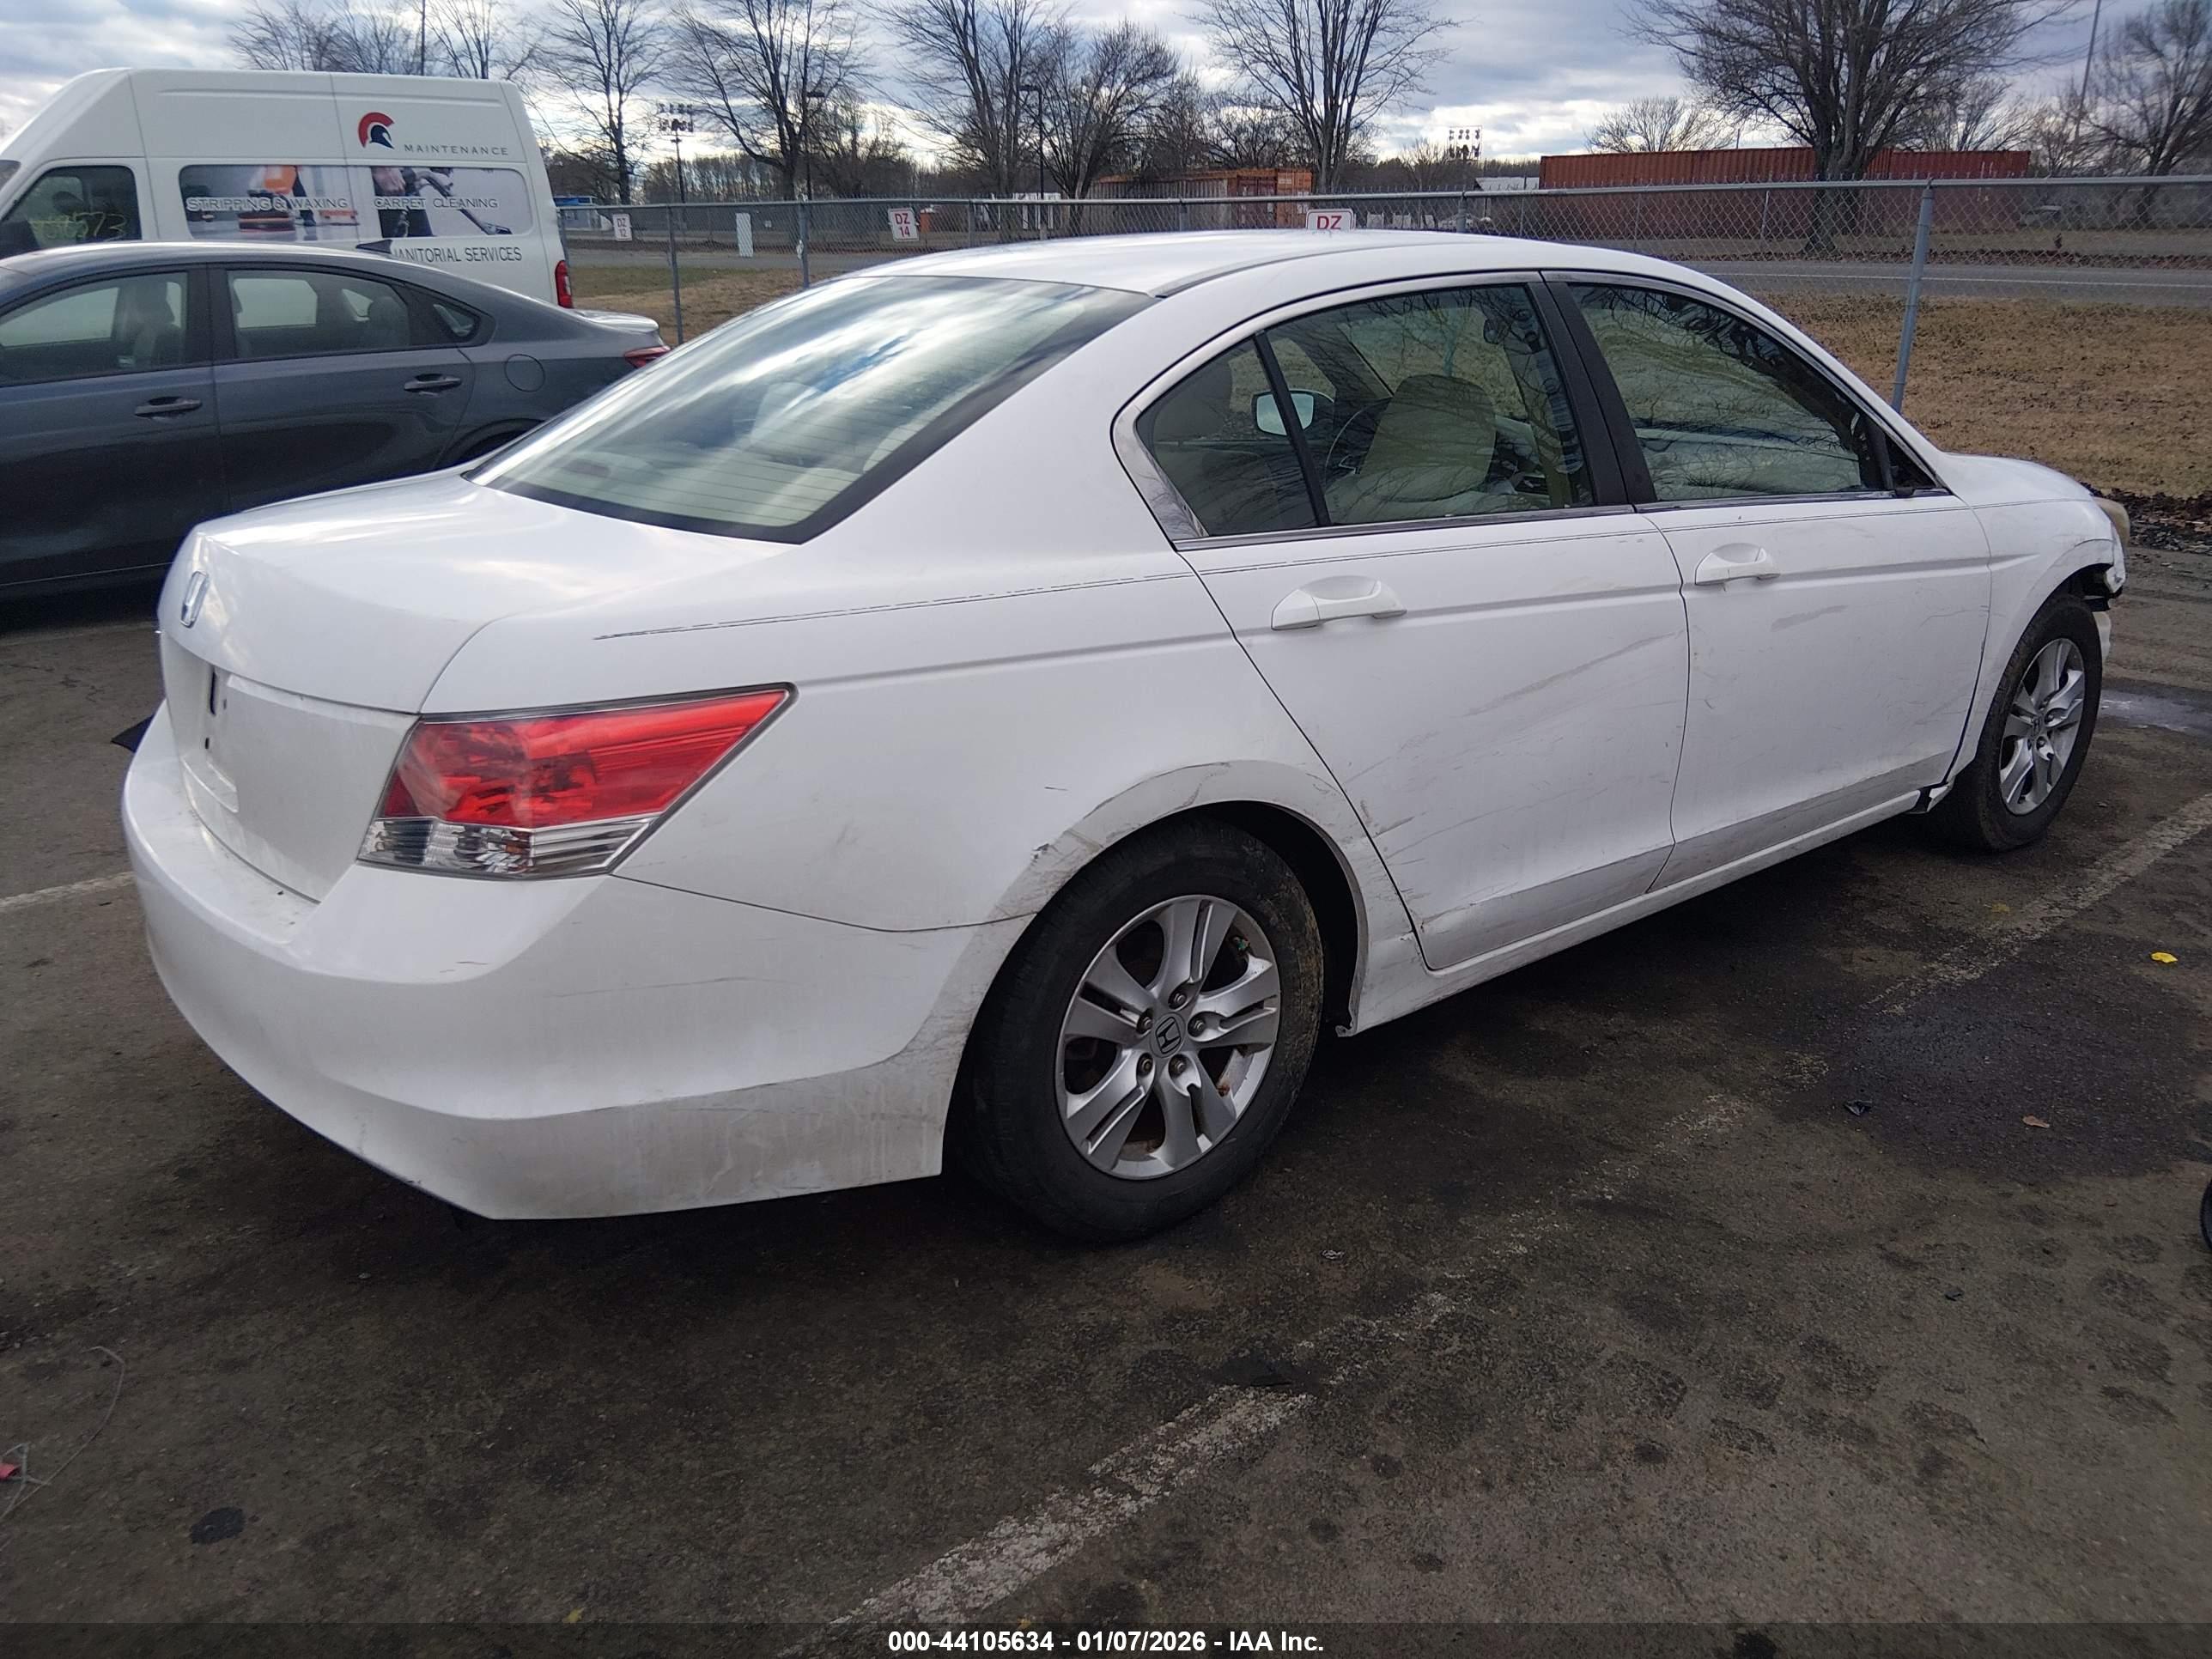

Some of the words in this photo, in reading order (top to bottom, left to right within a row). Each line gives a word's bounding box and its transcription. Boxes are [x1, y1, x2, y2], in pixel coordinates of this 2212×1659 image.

[404, 143, 508, 155] MAINTENANCE
[186, 198, 271, 210] STRIPPING
[273, 198, 287, 210] &
[291, 198, 348, 210] WAXING
[374, 198, 426, 210] CARPET
[433, 198, 498, 208] CLEANING
[617, 218, 627, 228] DZ
[894, 212, 910, 224] DZ
[1316, 216, 1342, 230] DZ
[899, 226, 910, 237] 14
[465, 246, 522, 261] SERVICES
